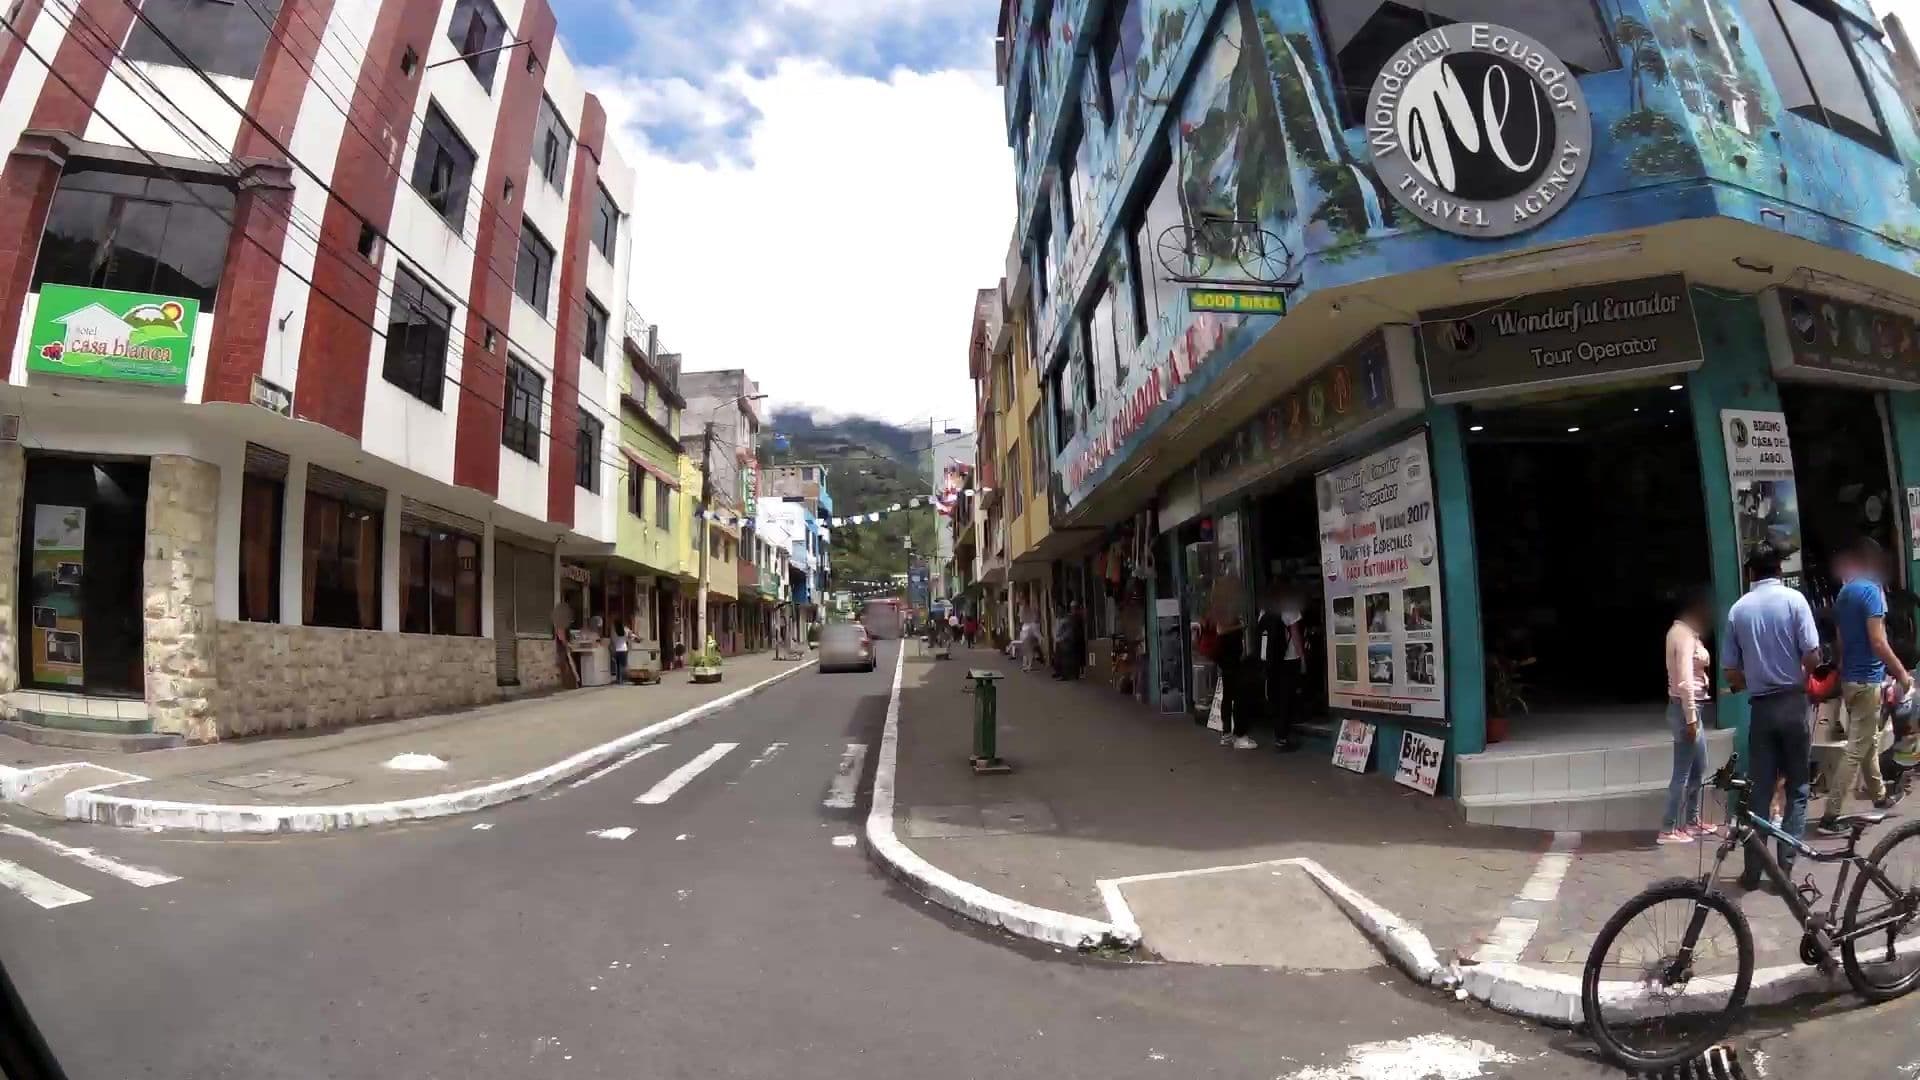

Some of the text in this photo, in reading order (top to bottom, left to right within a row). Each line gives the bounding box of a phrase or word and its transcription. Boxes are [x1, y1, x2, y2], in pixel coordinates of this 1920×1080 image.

[1369, 25, 1577, 156] Wonderful Ecuador
[1399, 140, 1582, 226] TRAVEL AGENCY
[1490, 301, 1599, 335] Wonderful
[1603, 290, 1681, 320] Ecuador
[71, 338, 107, 355] casa
[1531, 337, 1657, 368] Tour Operator
[1407, 501, 1430, 524] 2017
